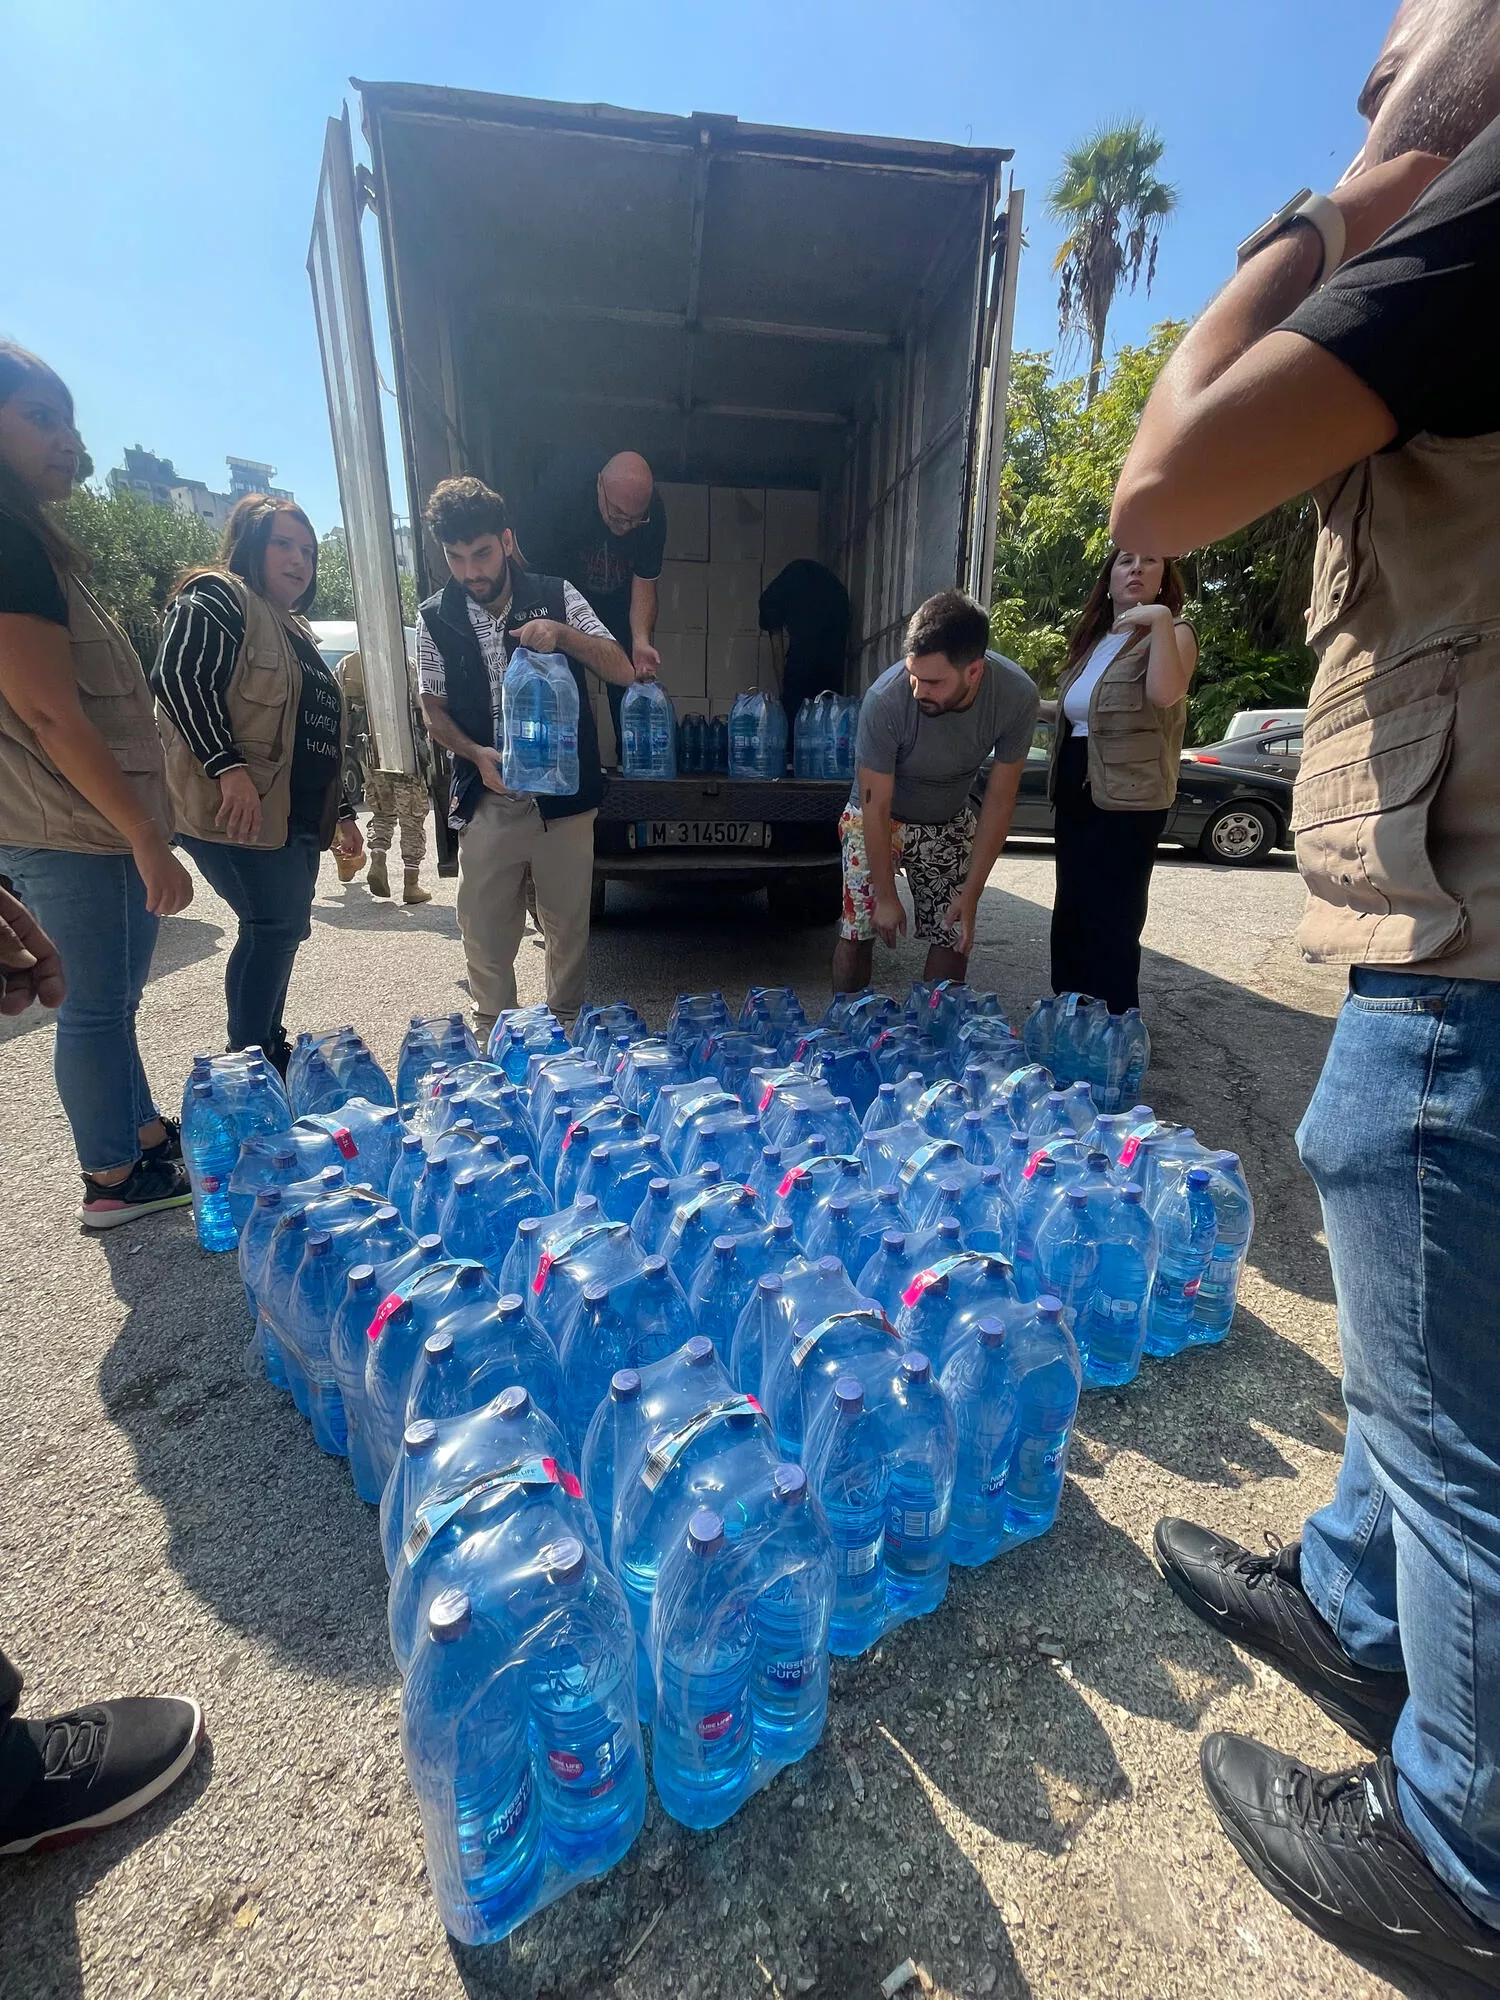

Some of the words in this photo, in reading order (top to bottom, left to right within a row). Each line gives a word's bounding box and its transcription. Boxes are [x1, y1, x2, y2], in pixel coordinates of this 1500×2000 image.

[529, 606, 549, 618] ADR
[652, 823, 667, 843] M
[678, 822, 750, 843] 314507
[766, 1664, 801, 1679] Pure
